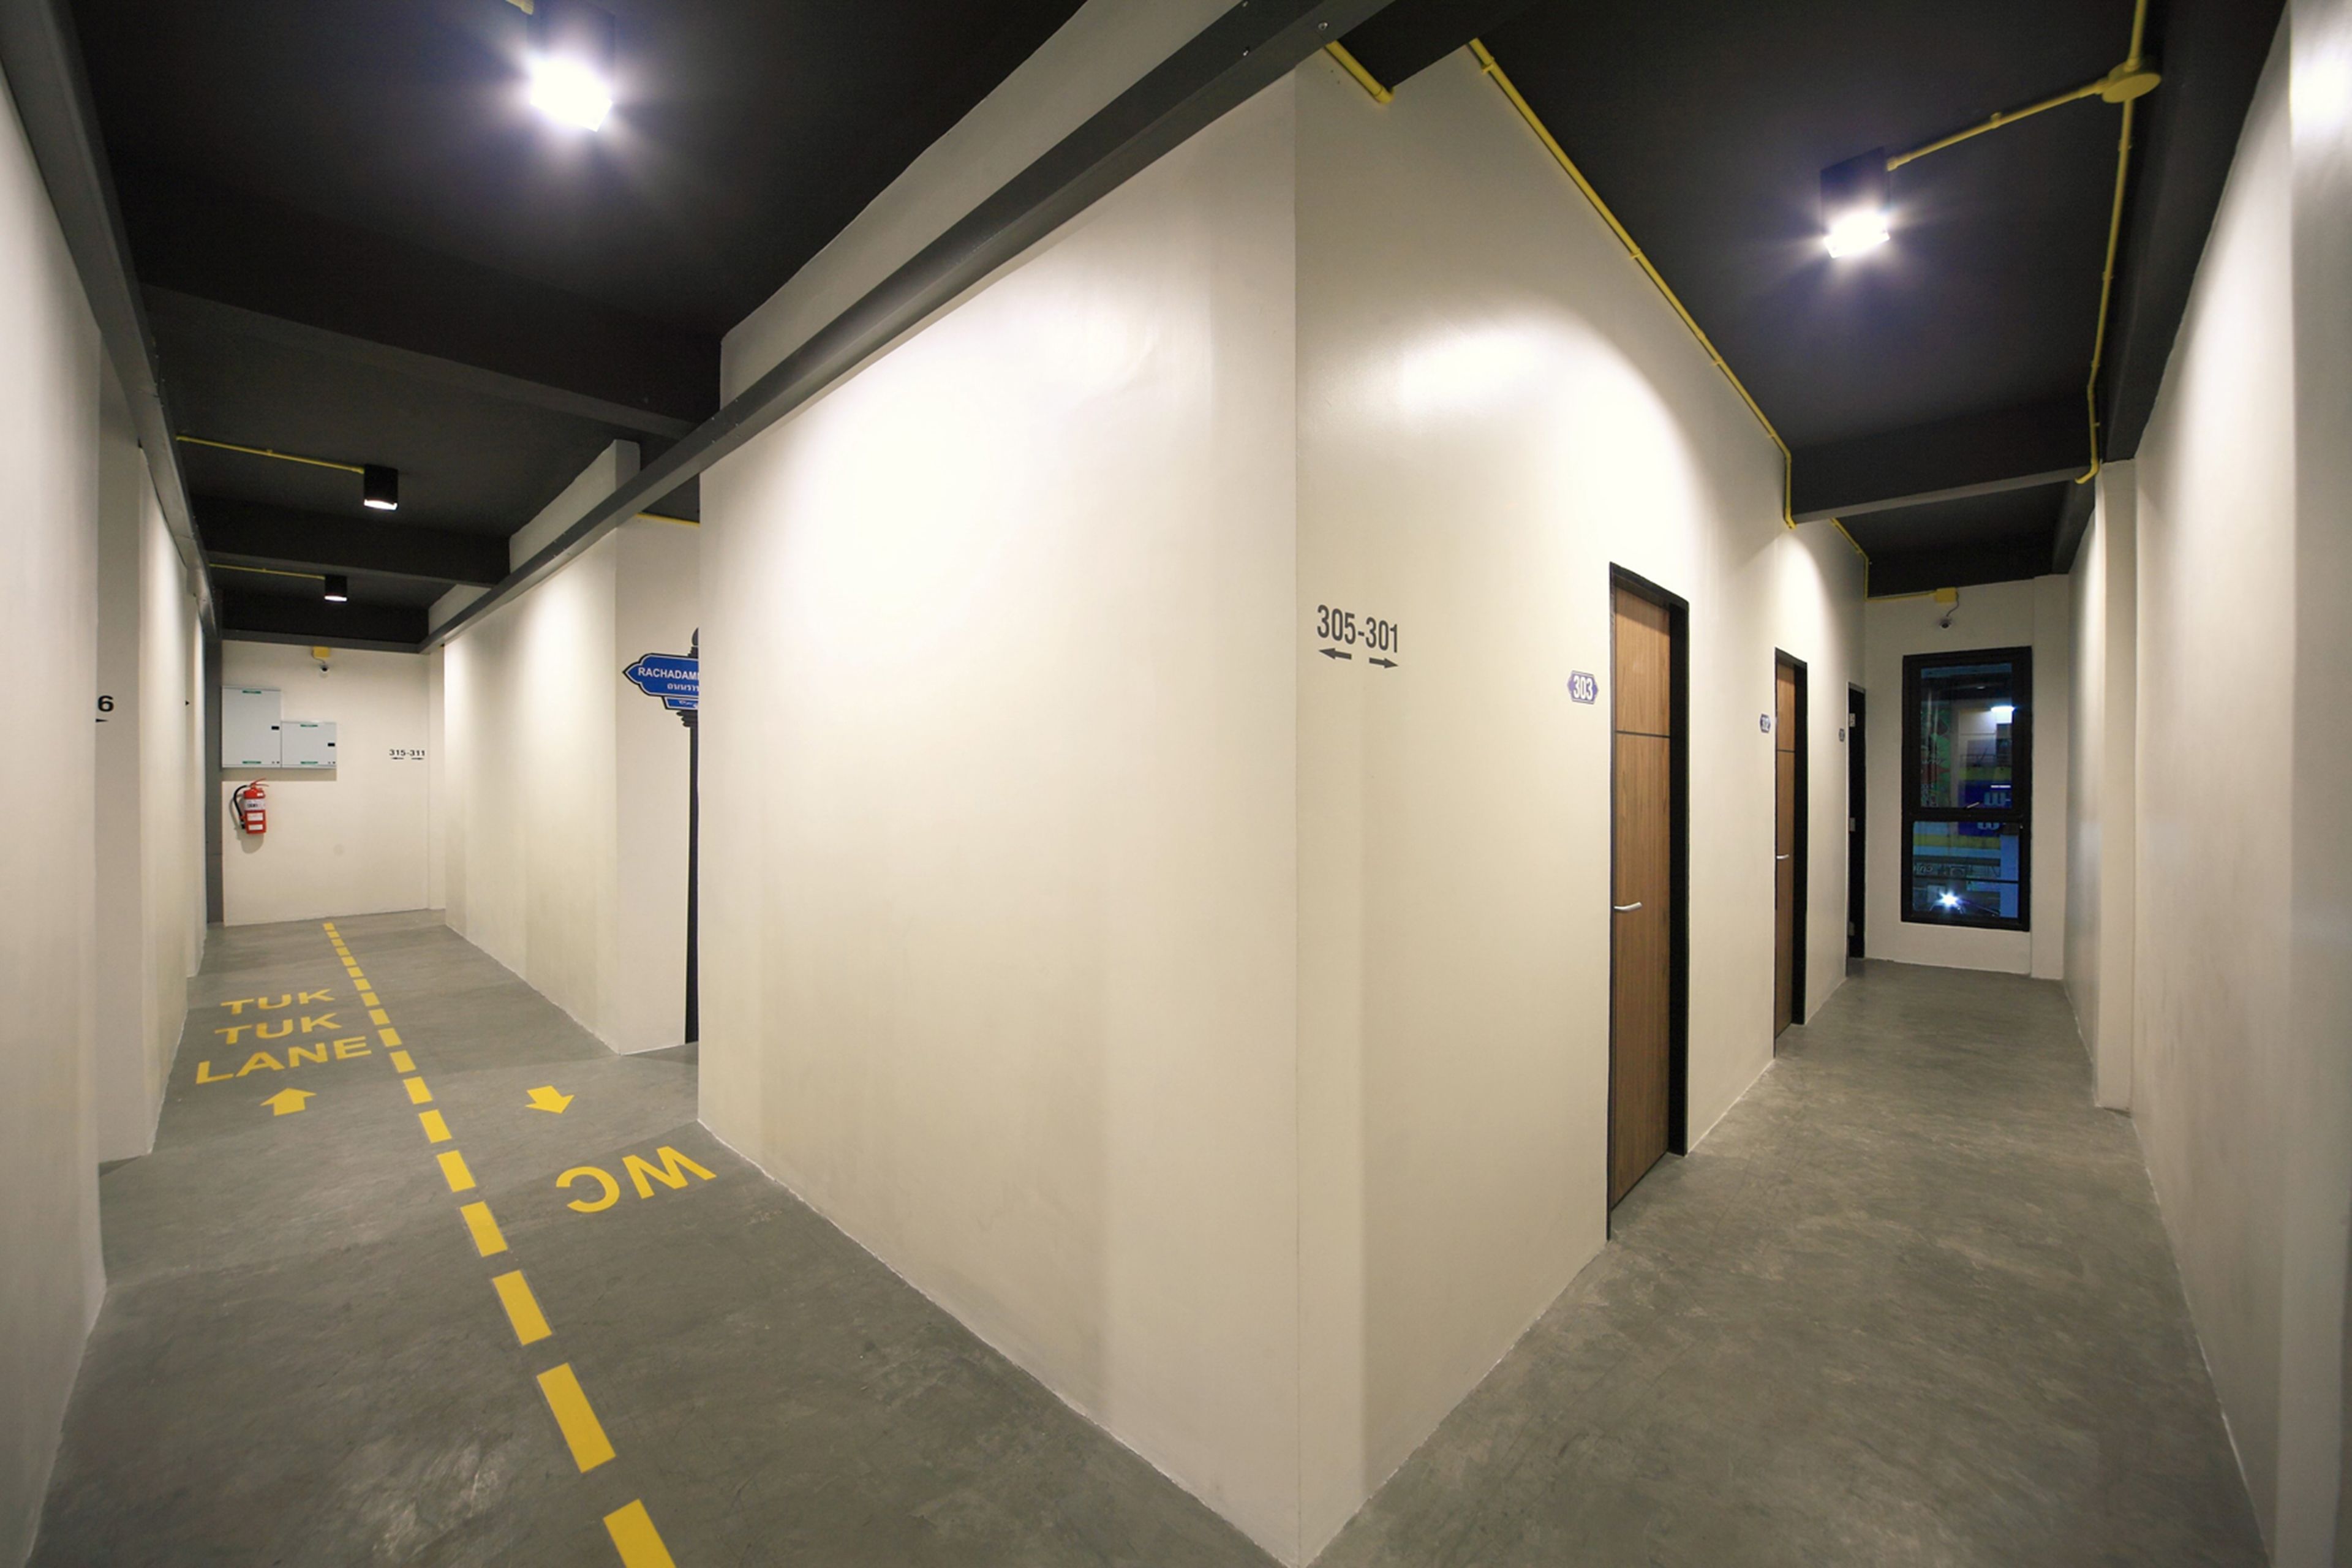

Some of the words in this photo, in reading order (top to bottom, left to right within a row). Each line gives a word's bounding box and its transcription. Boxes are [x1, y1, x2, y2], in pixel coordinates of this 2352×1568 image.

[1317, 604, 1398, 654] 305-301
[638, 667, 699, 680] RACHADAM
[1574, 675, 1593, 700] 303
[221, 989, 334, 1015] TUK
[216, 1012, 341, 1045] TUK
[195, 1035, 372, 1084] LANE
[555, 1145, 717, 1214] WC
